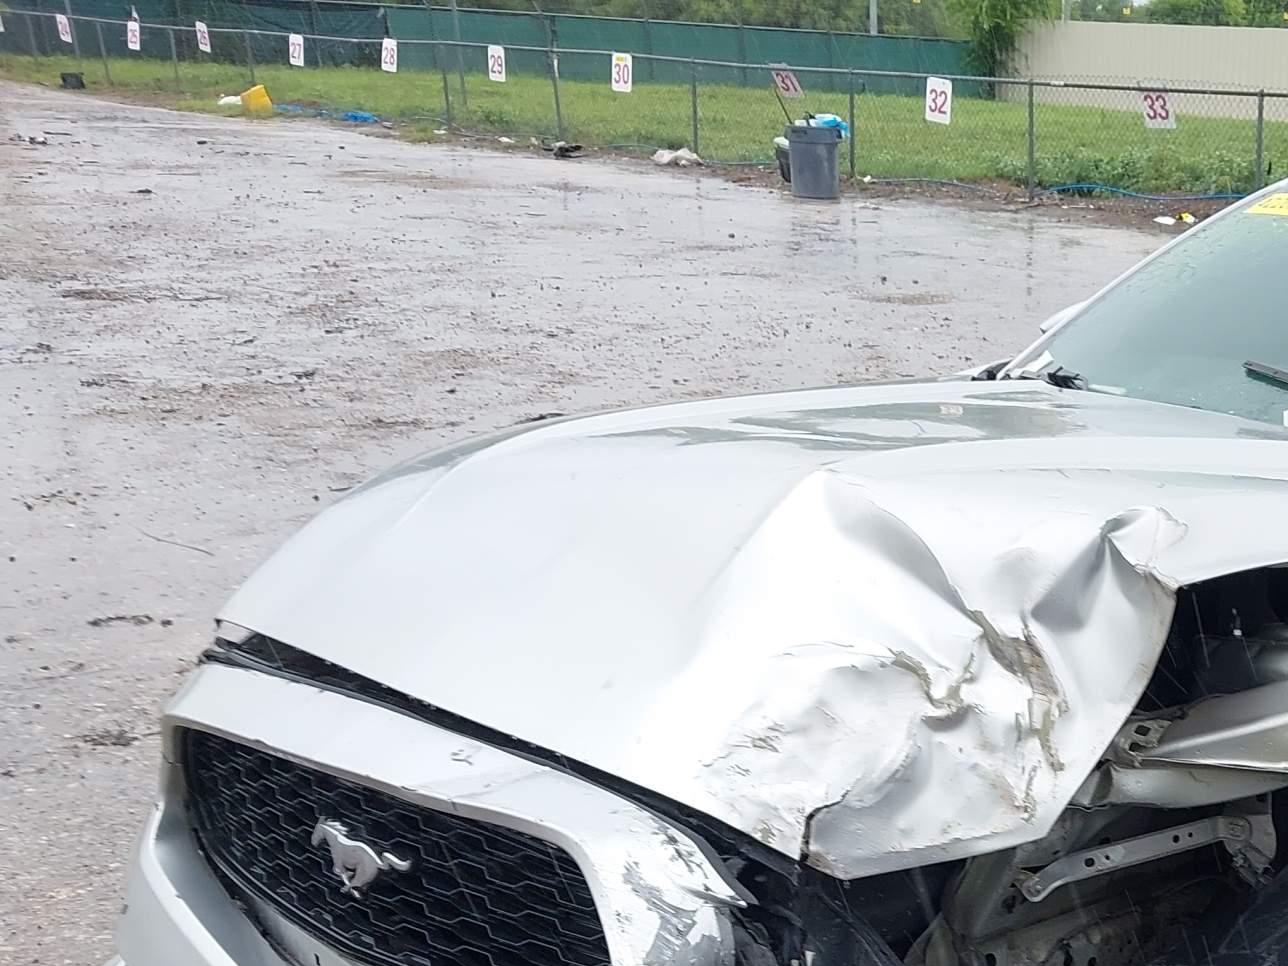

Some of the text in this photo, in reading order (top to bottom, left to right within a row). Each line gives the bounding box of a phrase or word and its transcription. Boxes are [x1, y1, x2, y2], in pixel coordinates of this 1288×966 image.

[290, 42, 302, 60] 27
[383, 47, 396, 66] 28
[489, 54, 503, 74] 29
[614, 63, 630, 85] 30
[775, 72, 798, 93] 31
[928, 88, 948, 115] 32
[1143, 94, 1169, 121] 33
